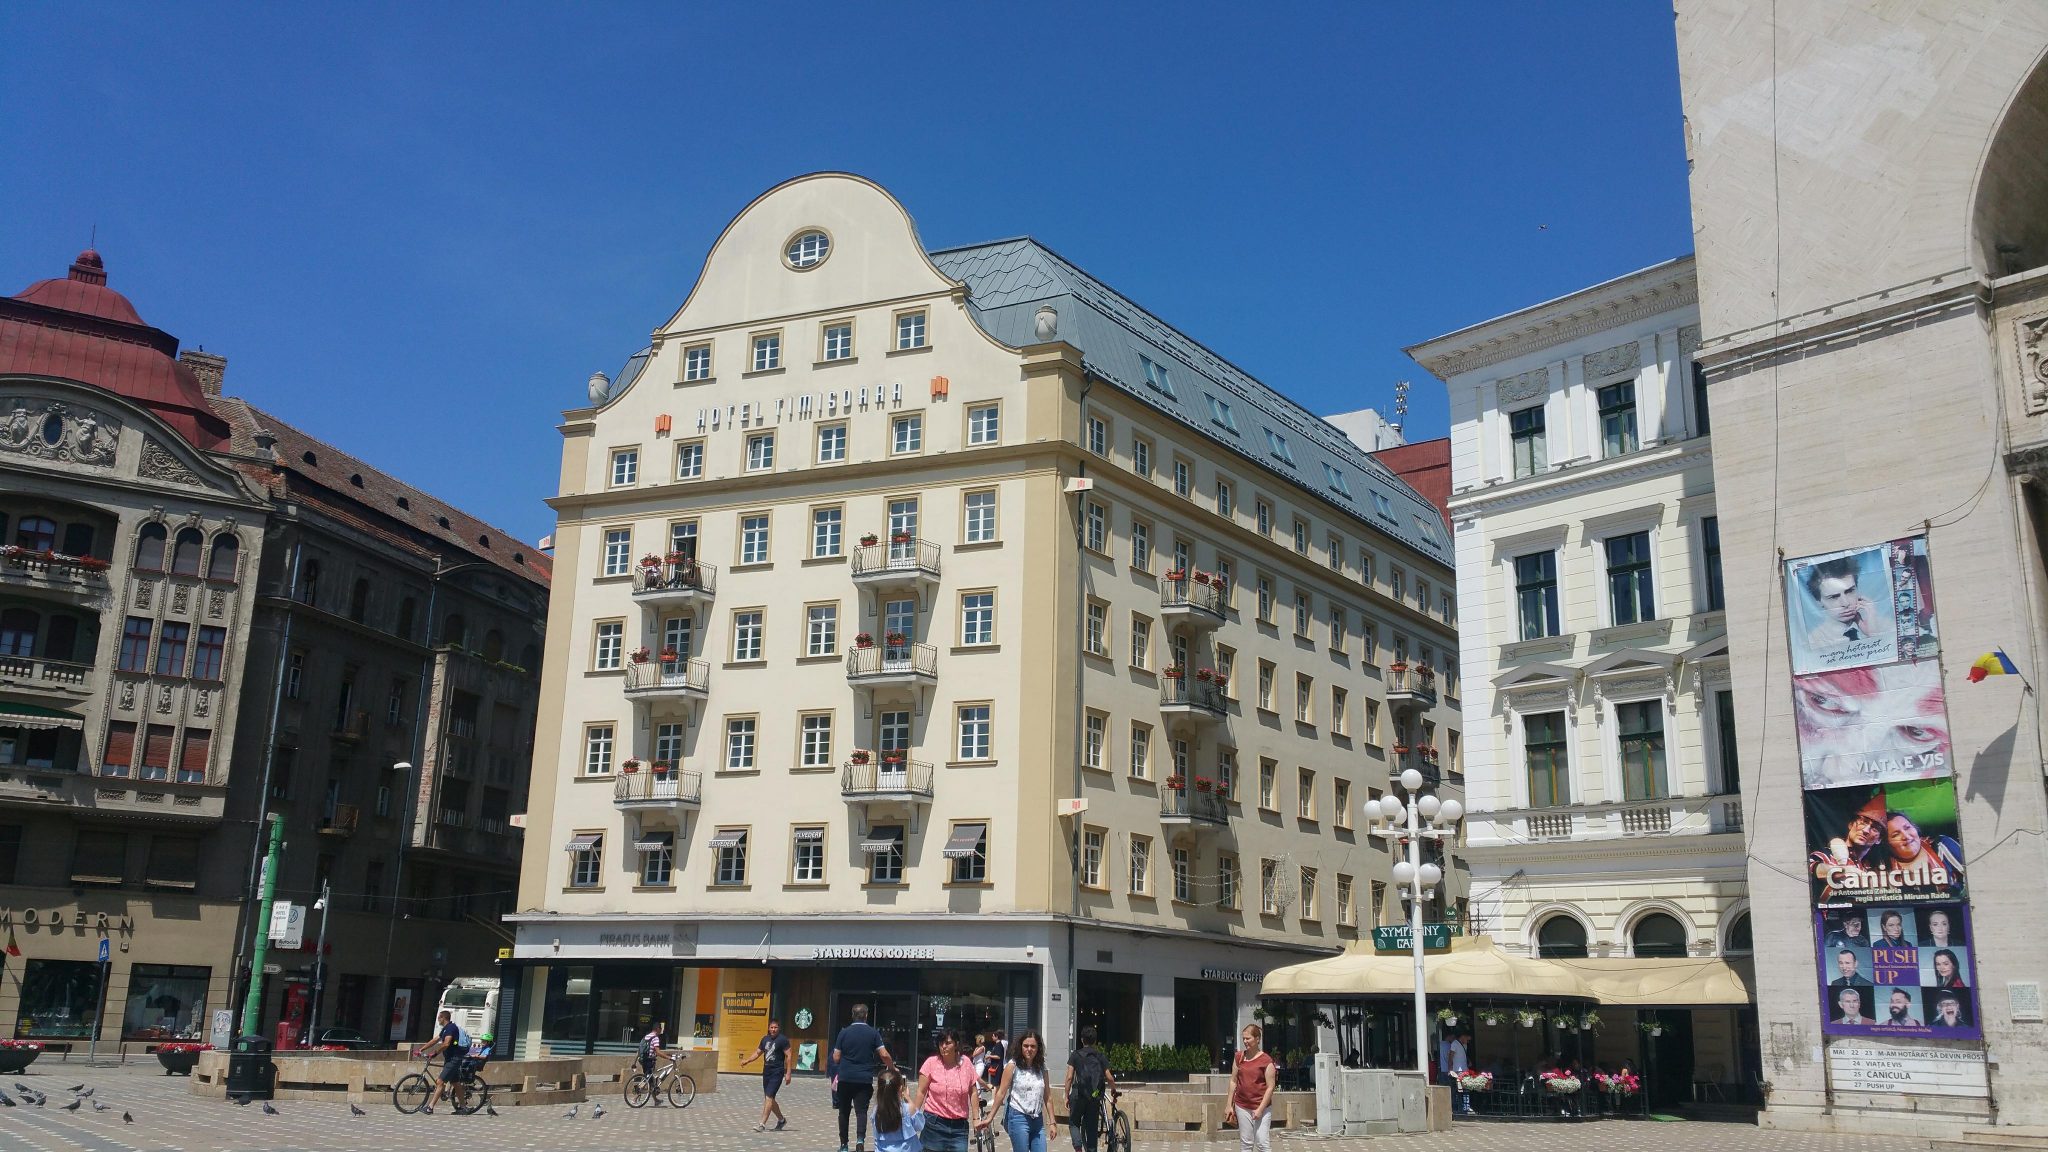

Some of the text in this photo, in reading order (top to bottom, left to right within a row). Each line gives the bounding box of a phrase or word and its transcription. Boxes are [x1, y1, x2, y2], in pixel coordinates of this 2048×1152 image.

[697, 383, 902, 427] HOTEL TIMISOARA
[1903, 755, 1914, 769] E
[1918, 752, 1945, 769] VIS
[1826, 862, 1949, 890] Canicula
[1380, 925, 1440, 938] SYMPHNY
[600, 933, 671, 946] PIRAEUS BANK
[812, 947, 935, 959] STARBUCKS COFFEE
[1873, 949, 1917, 963] PUSH
[1204, 968, 1265, 982] STARBUCKS COFFE
[1875, 970, 1899, 984] UP
[1940, 1052, 1961, 1060] DEVIN
[1866, 1070, 1912, 1080] CANICULA
